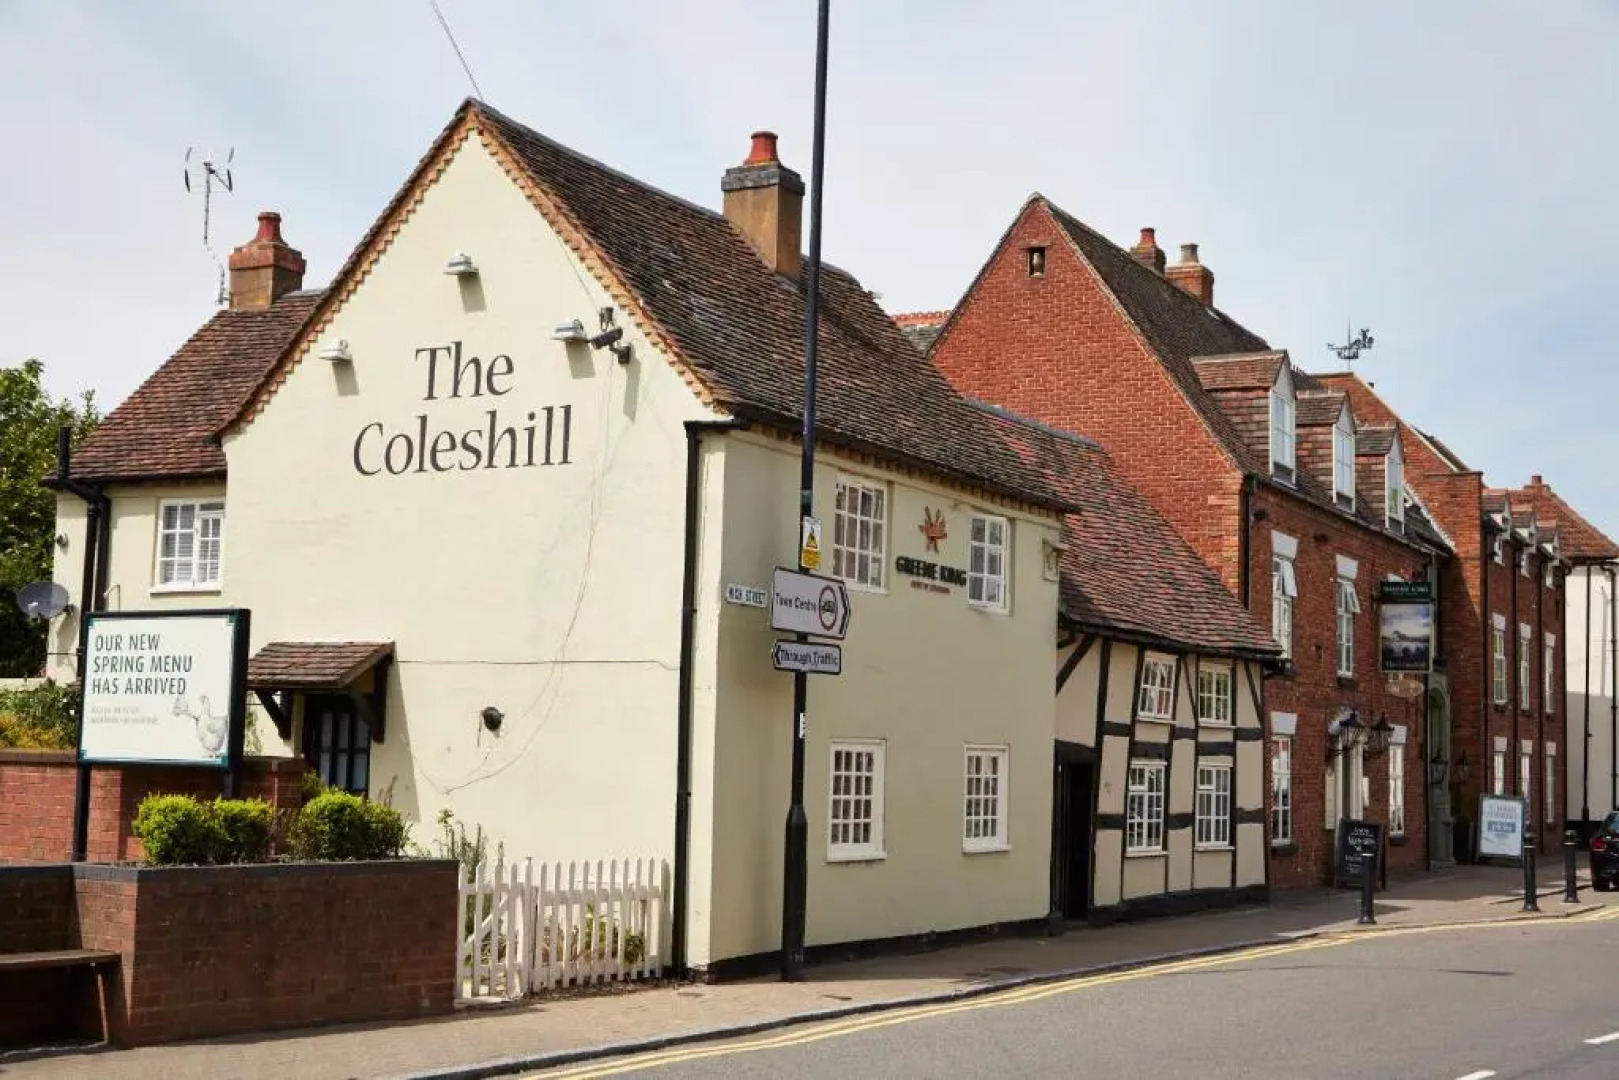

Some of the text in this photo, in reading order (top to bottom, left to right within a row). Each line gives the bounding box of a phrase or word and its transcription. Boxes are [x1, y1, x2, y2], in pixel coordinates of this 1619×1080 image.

[415, 341, 515, 400] The
[353, 404, 575, 476] Coleshill
[896, 556, 967, 586] GREENE KING
[775, 593, 793, 608] Town
[795, 596, 817, 612] Centre
[95, 633, 161, 652] OUR NEW
[93, 655, 193, 673] SPRING MENU
[780, 648, 839, 667] Through Traffic
[92, 677, 187, 695] HAS ARRIVED
